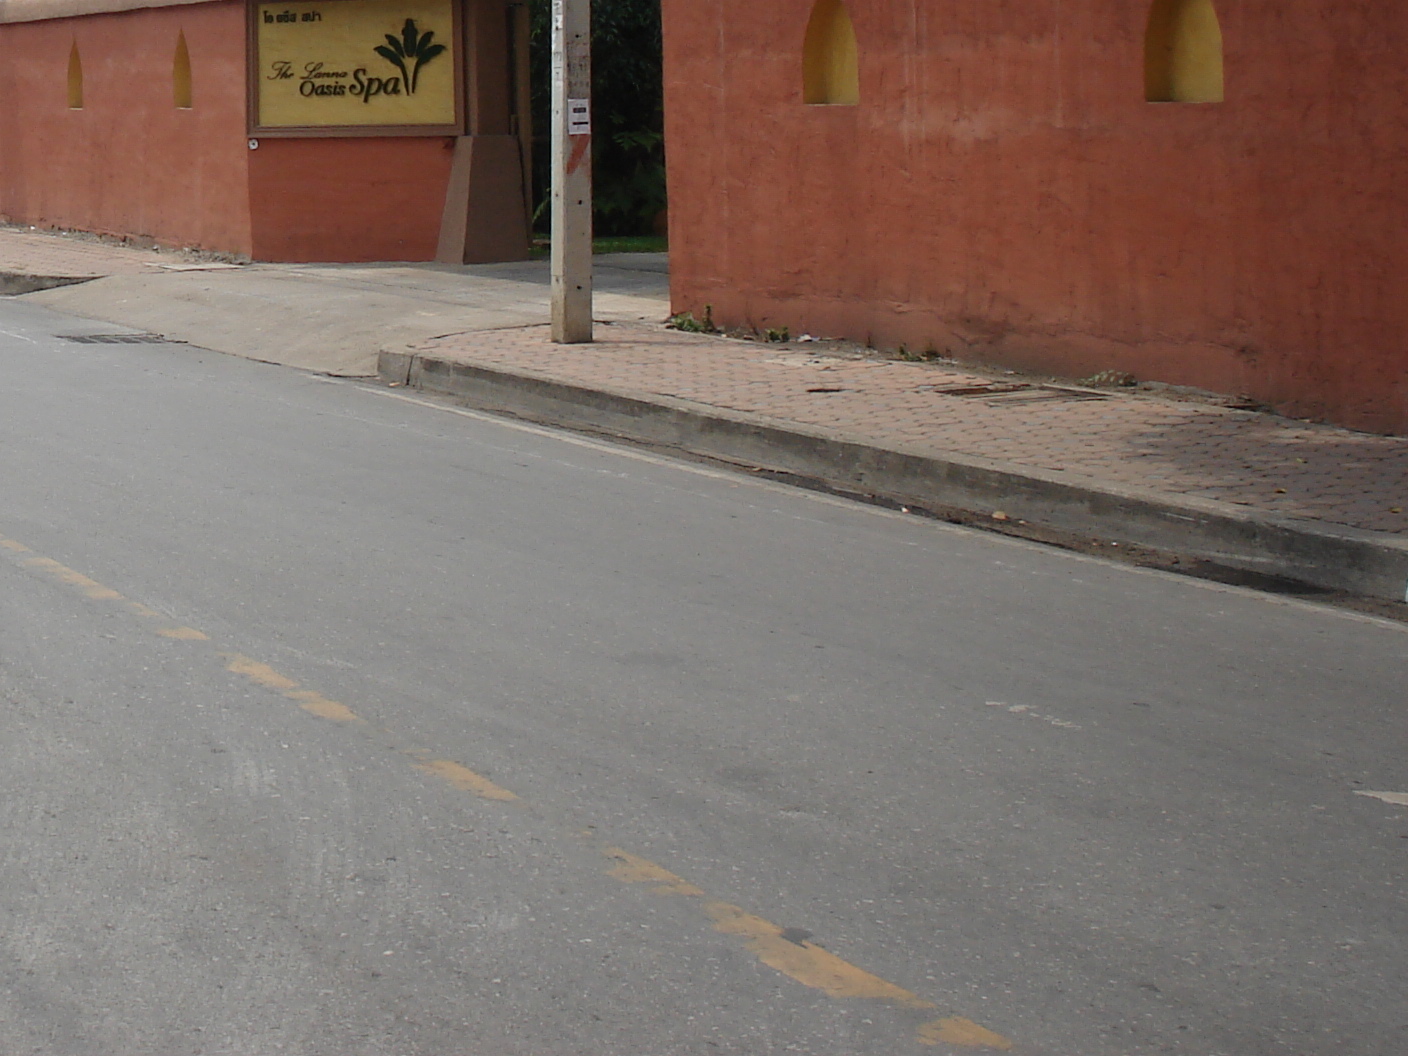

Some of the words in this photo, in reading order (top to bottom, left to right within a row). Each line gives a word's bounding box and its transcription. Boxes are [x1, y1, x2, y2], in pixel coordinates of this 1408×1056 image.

[267, 61, 294, 80] The
[299, 80, 346, 98] Oasis
[349, 68, 400, 103] Spa
